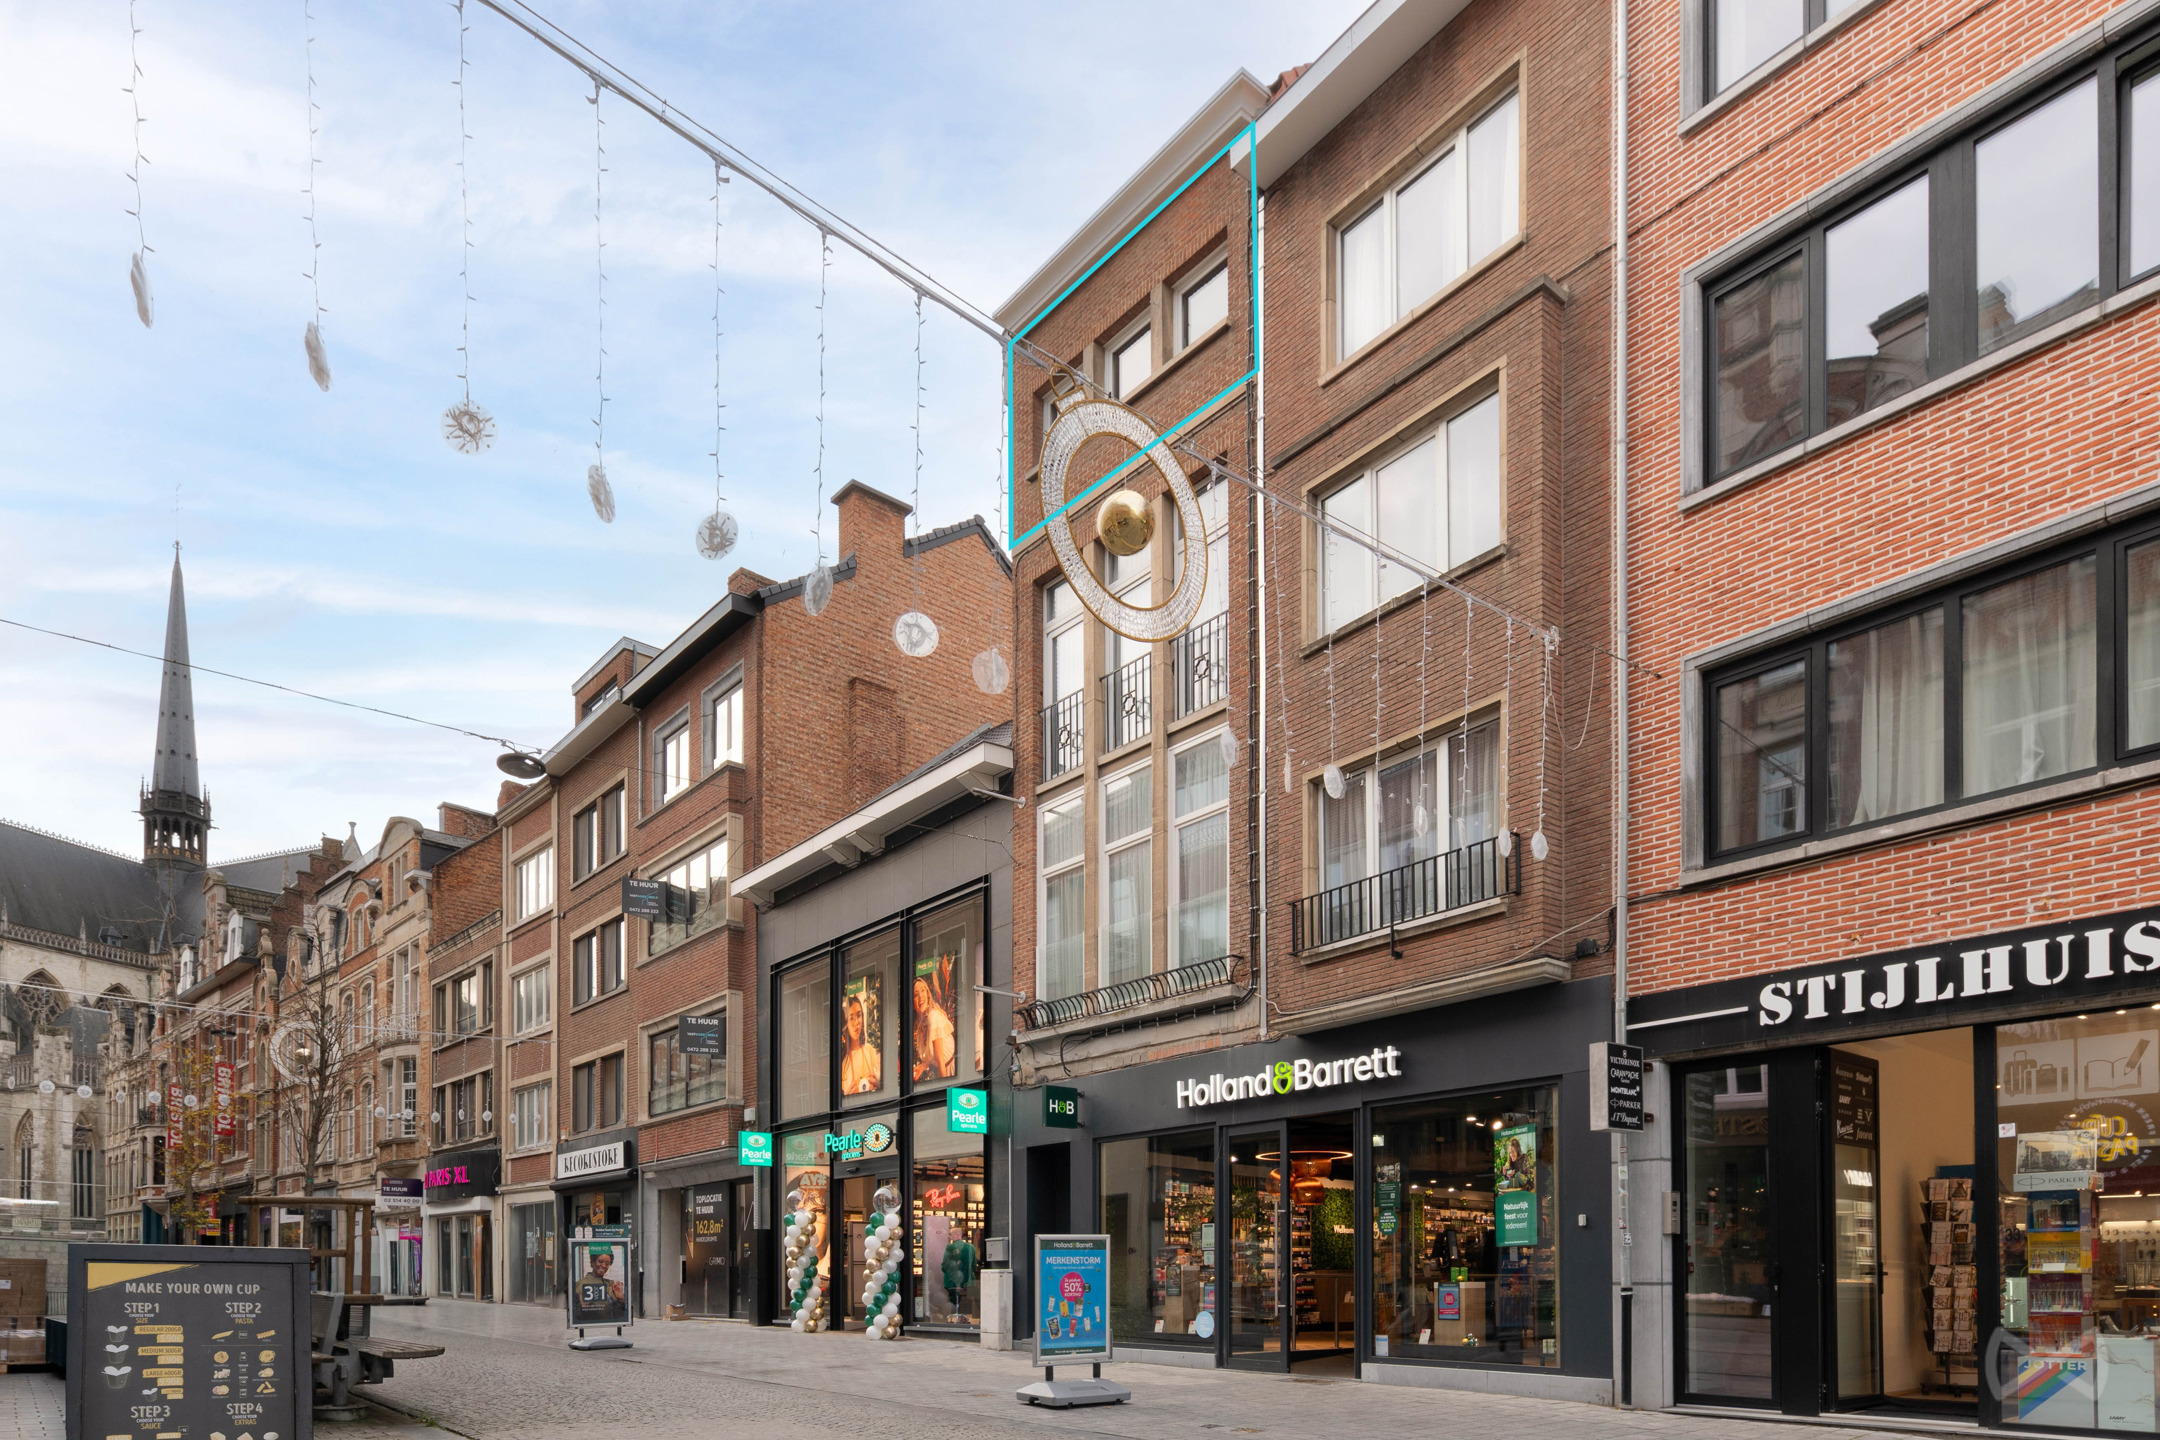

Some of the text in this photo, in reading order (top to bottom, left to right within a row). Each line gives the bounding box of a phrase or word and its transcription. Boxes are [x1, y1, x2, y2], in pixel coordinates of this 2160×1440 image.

[1759, 920, 2160, 1026] STIJLHUIS
[1610, 1056, 1640, 1068] VICTORINOX
[1611, 1086, 1637, 1096] MONTBLANC
[1620, 1100, 1640, 1109] PARKER
[952, 1110, 985, 1124] Pearle
[824, 1128, 863, 1153] Pearle
[742, 1148, 771, 1159] Pearle
[429, 1167, 451, 1188] PARIS
[454, 1166, 469, 1184] XL
[696, 1194, 722, 1203] TOPLOCATIE
[702, 1206, 713, 1214] HUUR
[1504, 1202, 1528, 1211] Natuurlijk
[2005, 1228, 2021, 1242] 33
[1046, 1256, 1100, 1264] MERKENSTORM
[126, 1282, 260, 1294] MAKE YOUR OWN CUP
[584, 1286, 593, 1300] 3
[599, 1286, 605, 1300] 1
[1064, 1283, 1082, 1292] 50%
[124, 1303, 160, 1313] STEP 1
[225, 1302, 262, 1313] STEP 2
[2023, 1359, 2087, 1371] JOTTER
[130, 1405, 171, 1418] STEP 3
[226, 1403, 263, 1415] STEP 4
